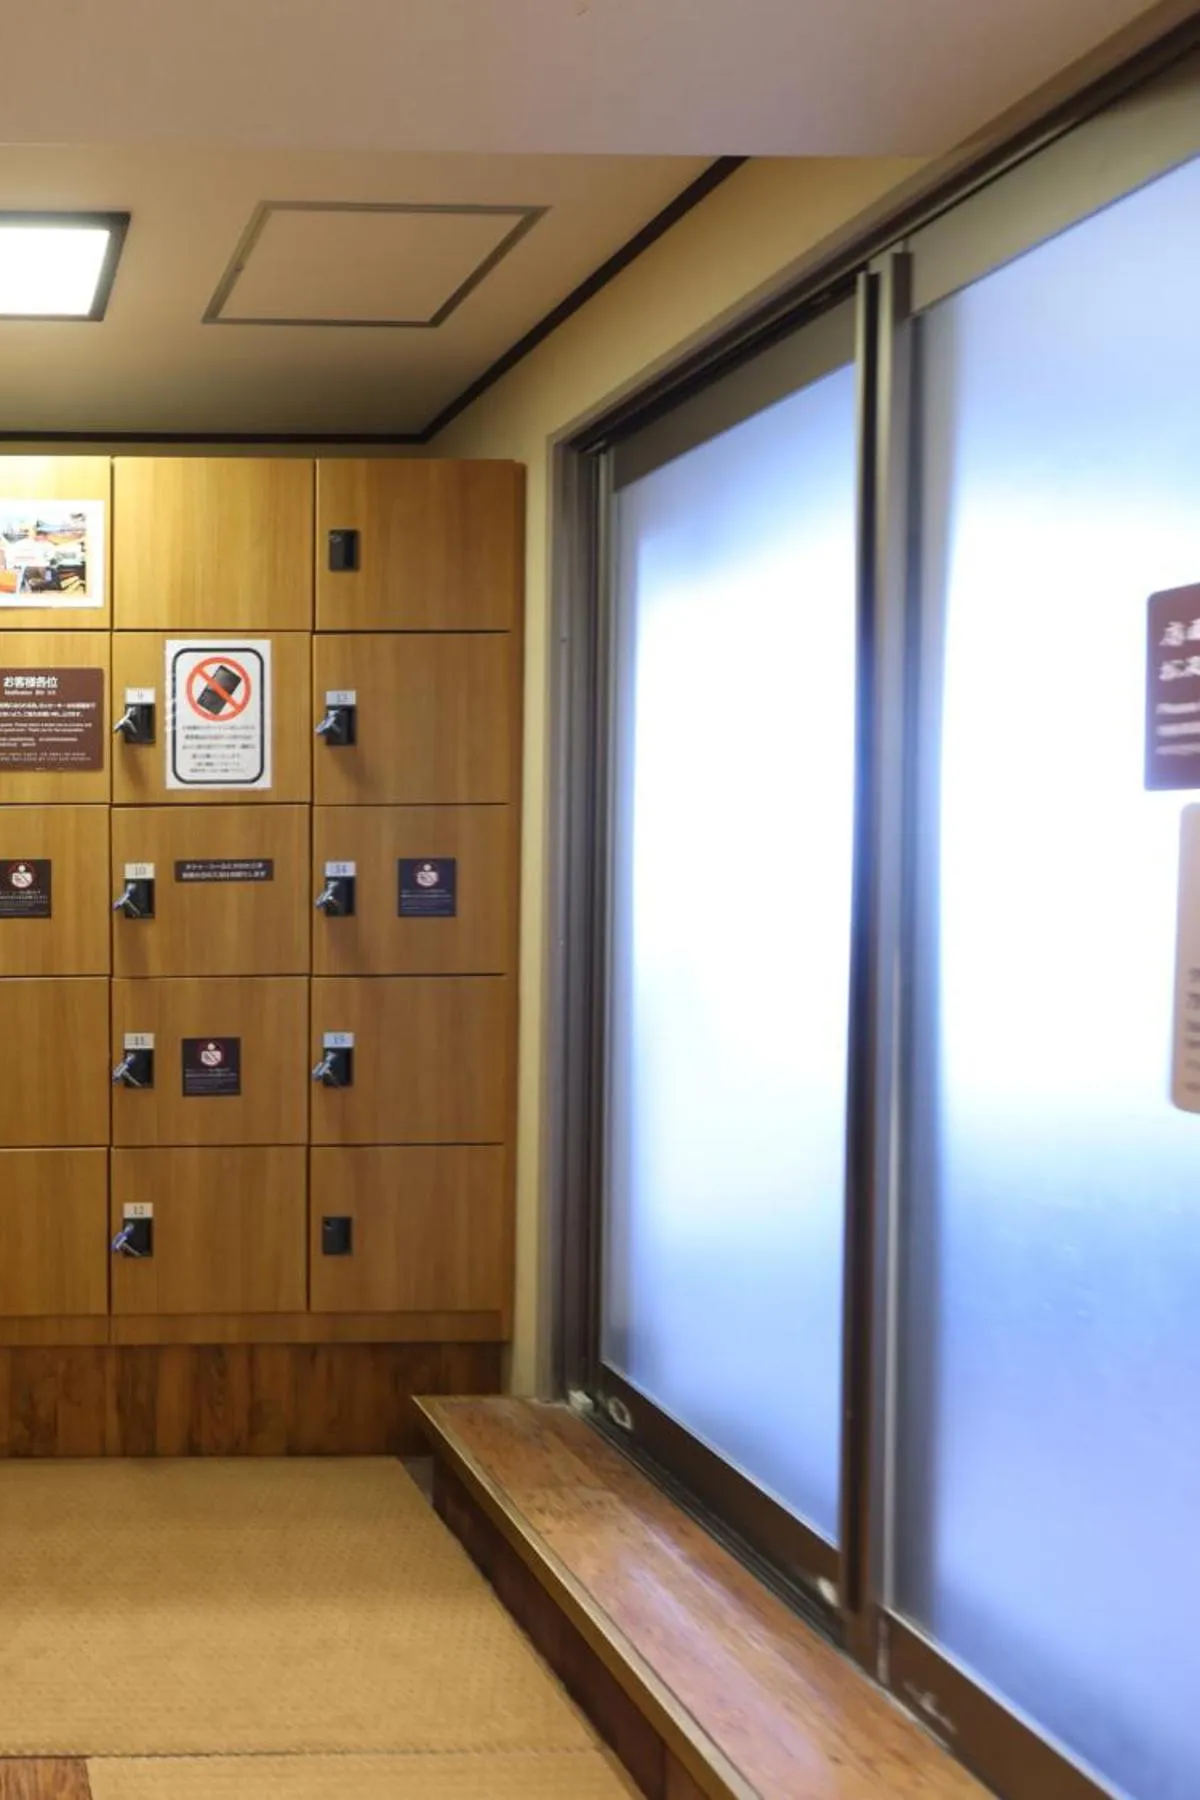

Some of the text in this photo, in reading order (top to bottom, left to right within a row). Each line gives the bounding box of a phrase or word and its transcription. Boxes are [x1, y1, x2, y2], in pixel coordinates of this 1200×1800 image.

[3, 676, 59, 689] お客様各位
